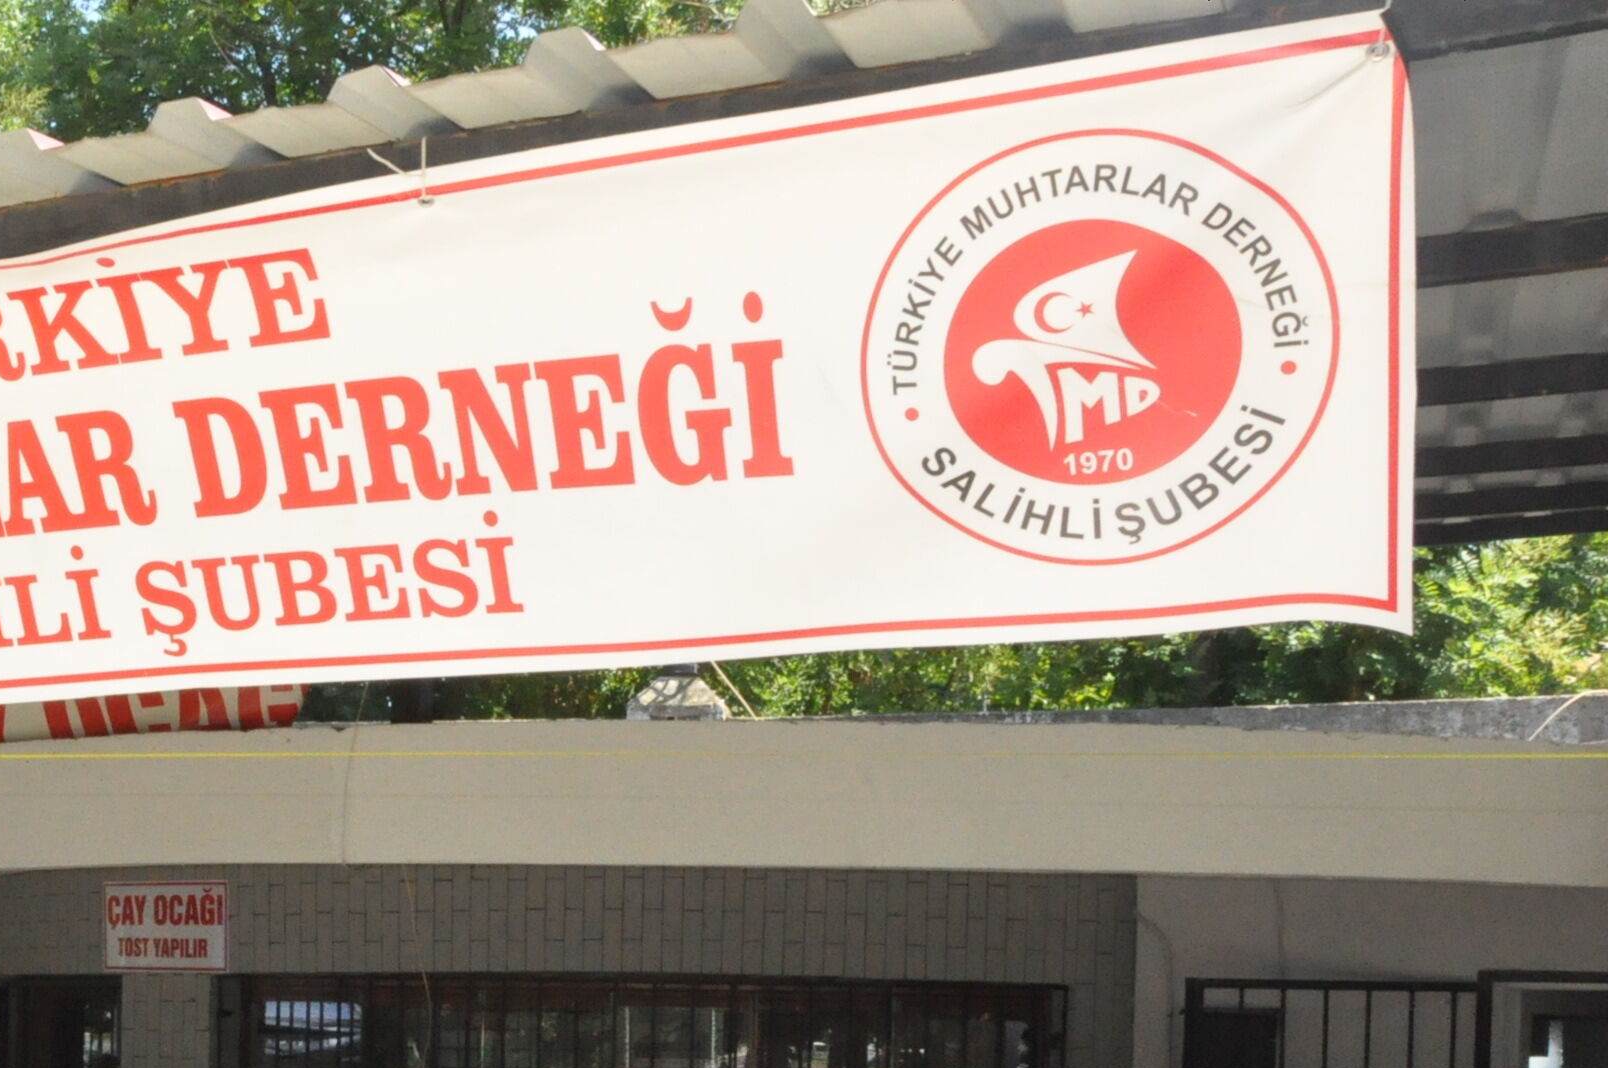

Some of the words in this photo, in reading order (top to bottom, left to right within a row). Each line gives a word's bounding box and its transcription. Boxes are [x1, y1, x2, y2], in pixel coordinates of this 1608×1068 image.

[886, 236, 964, 396] TÜRKİYE
[959, 163, 1200, 241] MUHTARLAR
[1201, 201, 1309, 349] DERNEĞİ
[173, 291, 794, 518] DERNEĞİ
[920, 446, 1103, 541] SALİHLİ
[1114, 403, 1287, 545] ŞUBESİ
[1063, 447, 1134, 476] 1970
[135, 511, 525, 657] ŞUBESİ
[108, 894, 146, 930] ÇAY
[153, 887, 223, 926] OCAĞI
[118, 937, 149, 957] TOST
[153, 937, 208, 958] YAPILIR
